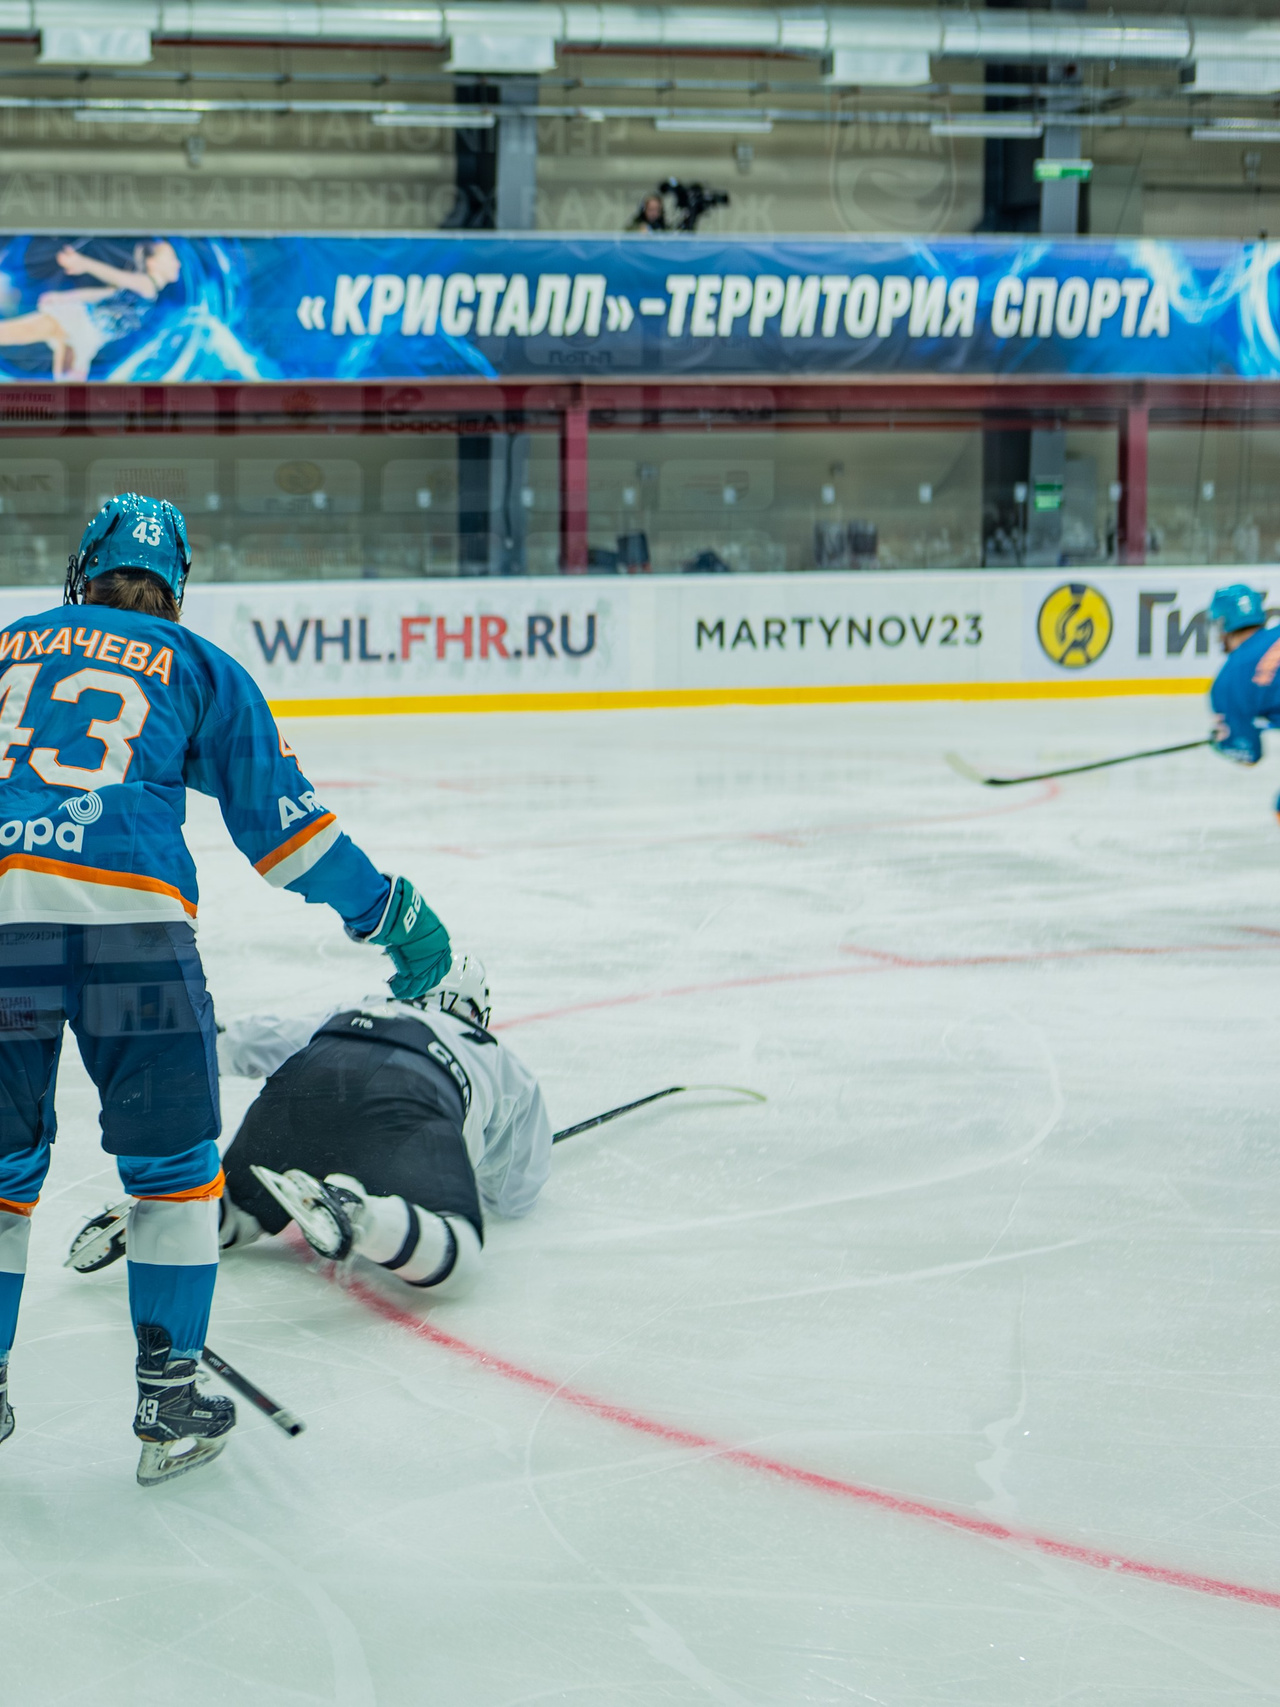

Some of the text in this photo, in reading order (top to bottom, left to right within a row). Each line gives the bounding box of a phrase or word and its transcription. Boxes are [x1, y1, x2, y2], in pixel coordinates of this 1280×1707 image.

[990, 276, 1170, 338] СПОРТА
[132, 521, 161, 547] 43
[252, 613, 597, 665] WHL.FHR.RU
[696, 614, 984, 650] MARTYNOV23
[439, 991, 459, 1011] 17
[137, 1399, 160, 1424] 43
